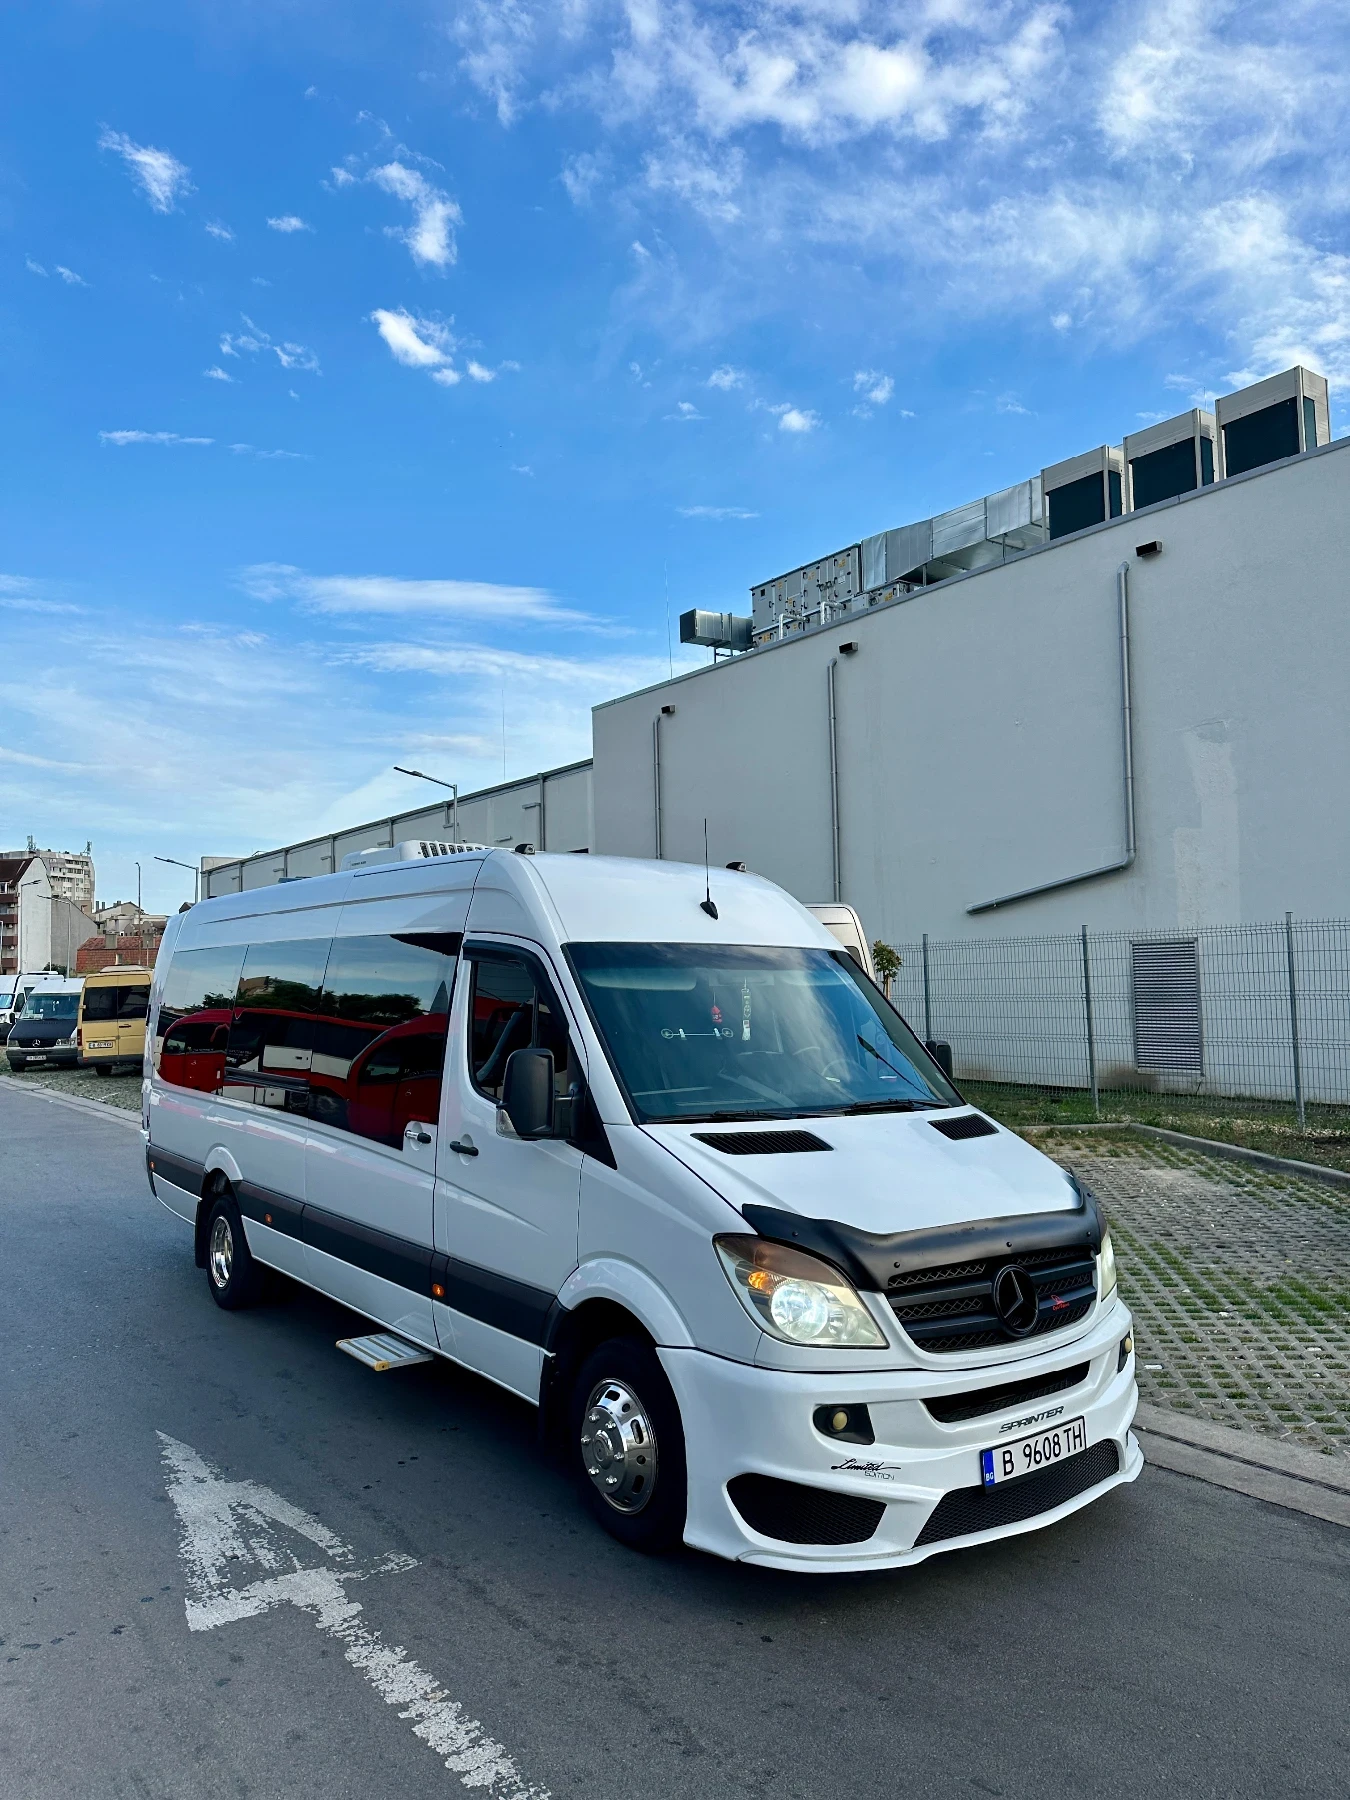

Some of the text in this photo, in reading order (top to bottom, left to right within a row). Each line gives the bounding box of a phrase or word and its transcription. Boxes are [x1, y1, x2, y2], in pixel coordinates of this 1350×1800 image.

[999, 1405, 1064, 1433] SPRINTER
[1002, 1423, 1083, 1476] B 9608 TH
[831, 1458, 901, 1471] Limited
[864, 1470, 895, 1480] EDITION
[985, 1472, 994, 1482] BG
